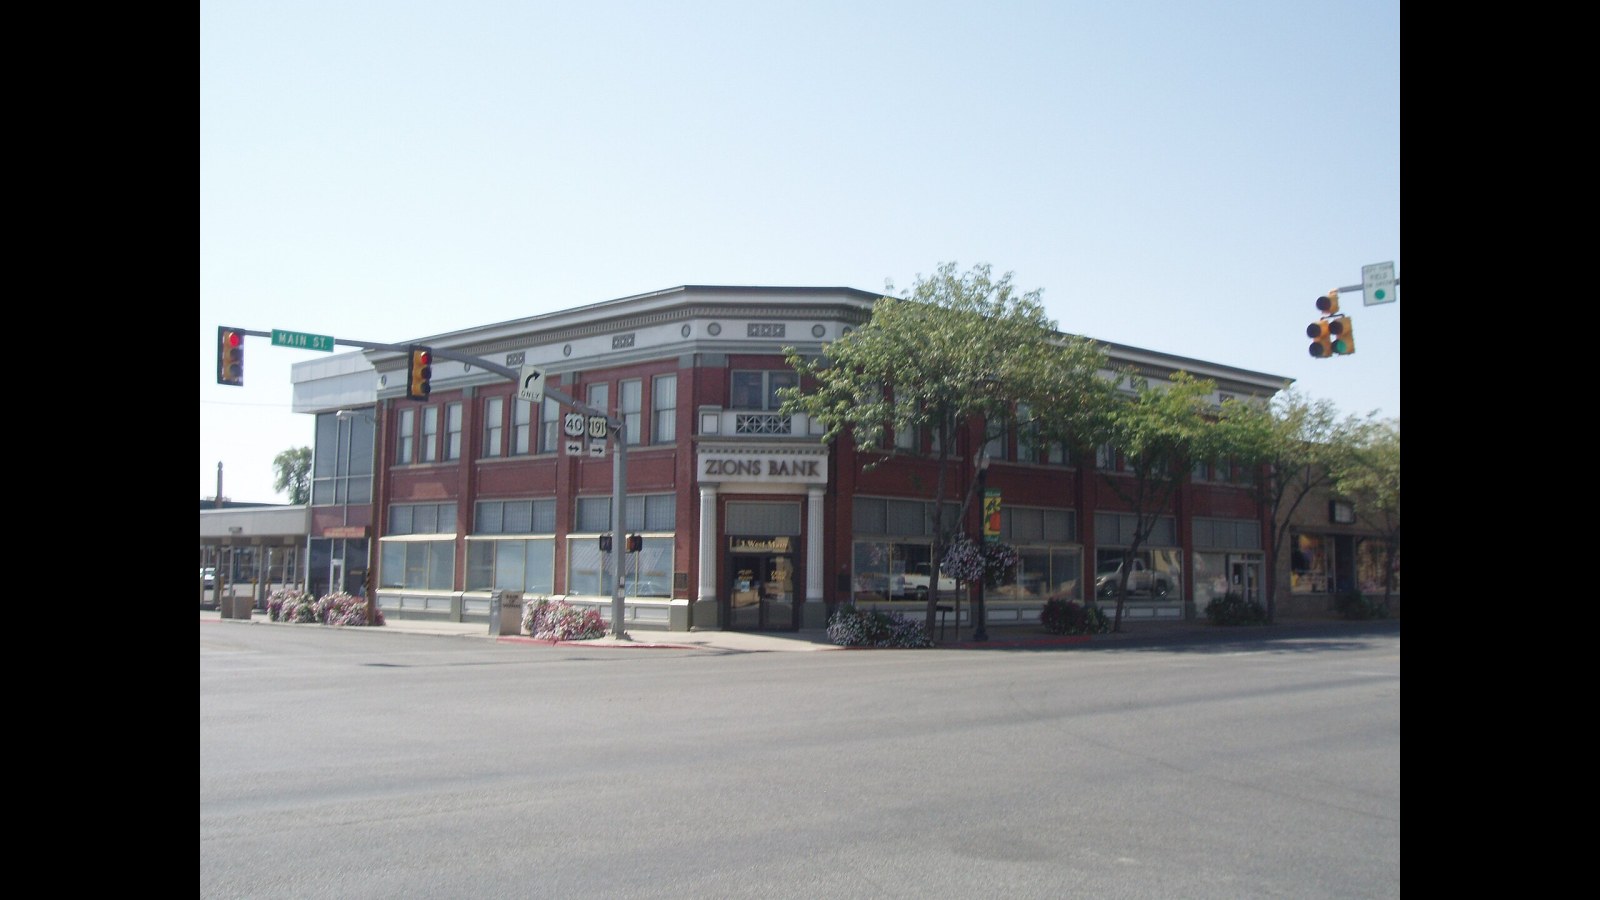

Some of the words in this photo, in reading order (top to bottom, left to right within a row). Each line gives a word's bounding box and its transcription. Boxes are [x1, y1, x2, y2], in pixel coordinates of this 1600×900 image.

[278, 332, 307, 347] MAIN
[520, 390, 540, 399] ONLY
[566, 418, 583, 431] 40
[591, 420, 605, 434] 191
[705, 459, 762, 476] ZIONS
[767, 460, 821, 477] BANK
[747, 540, 765, 548] West
